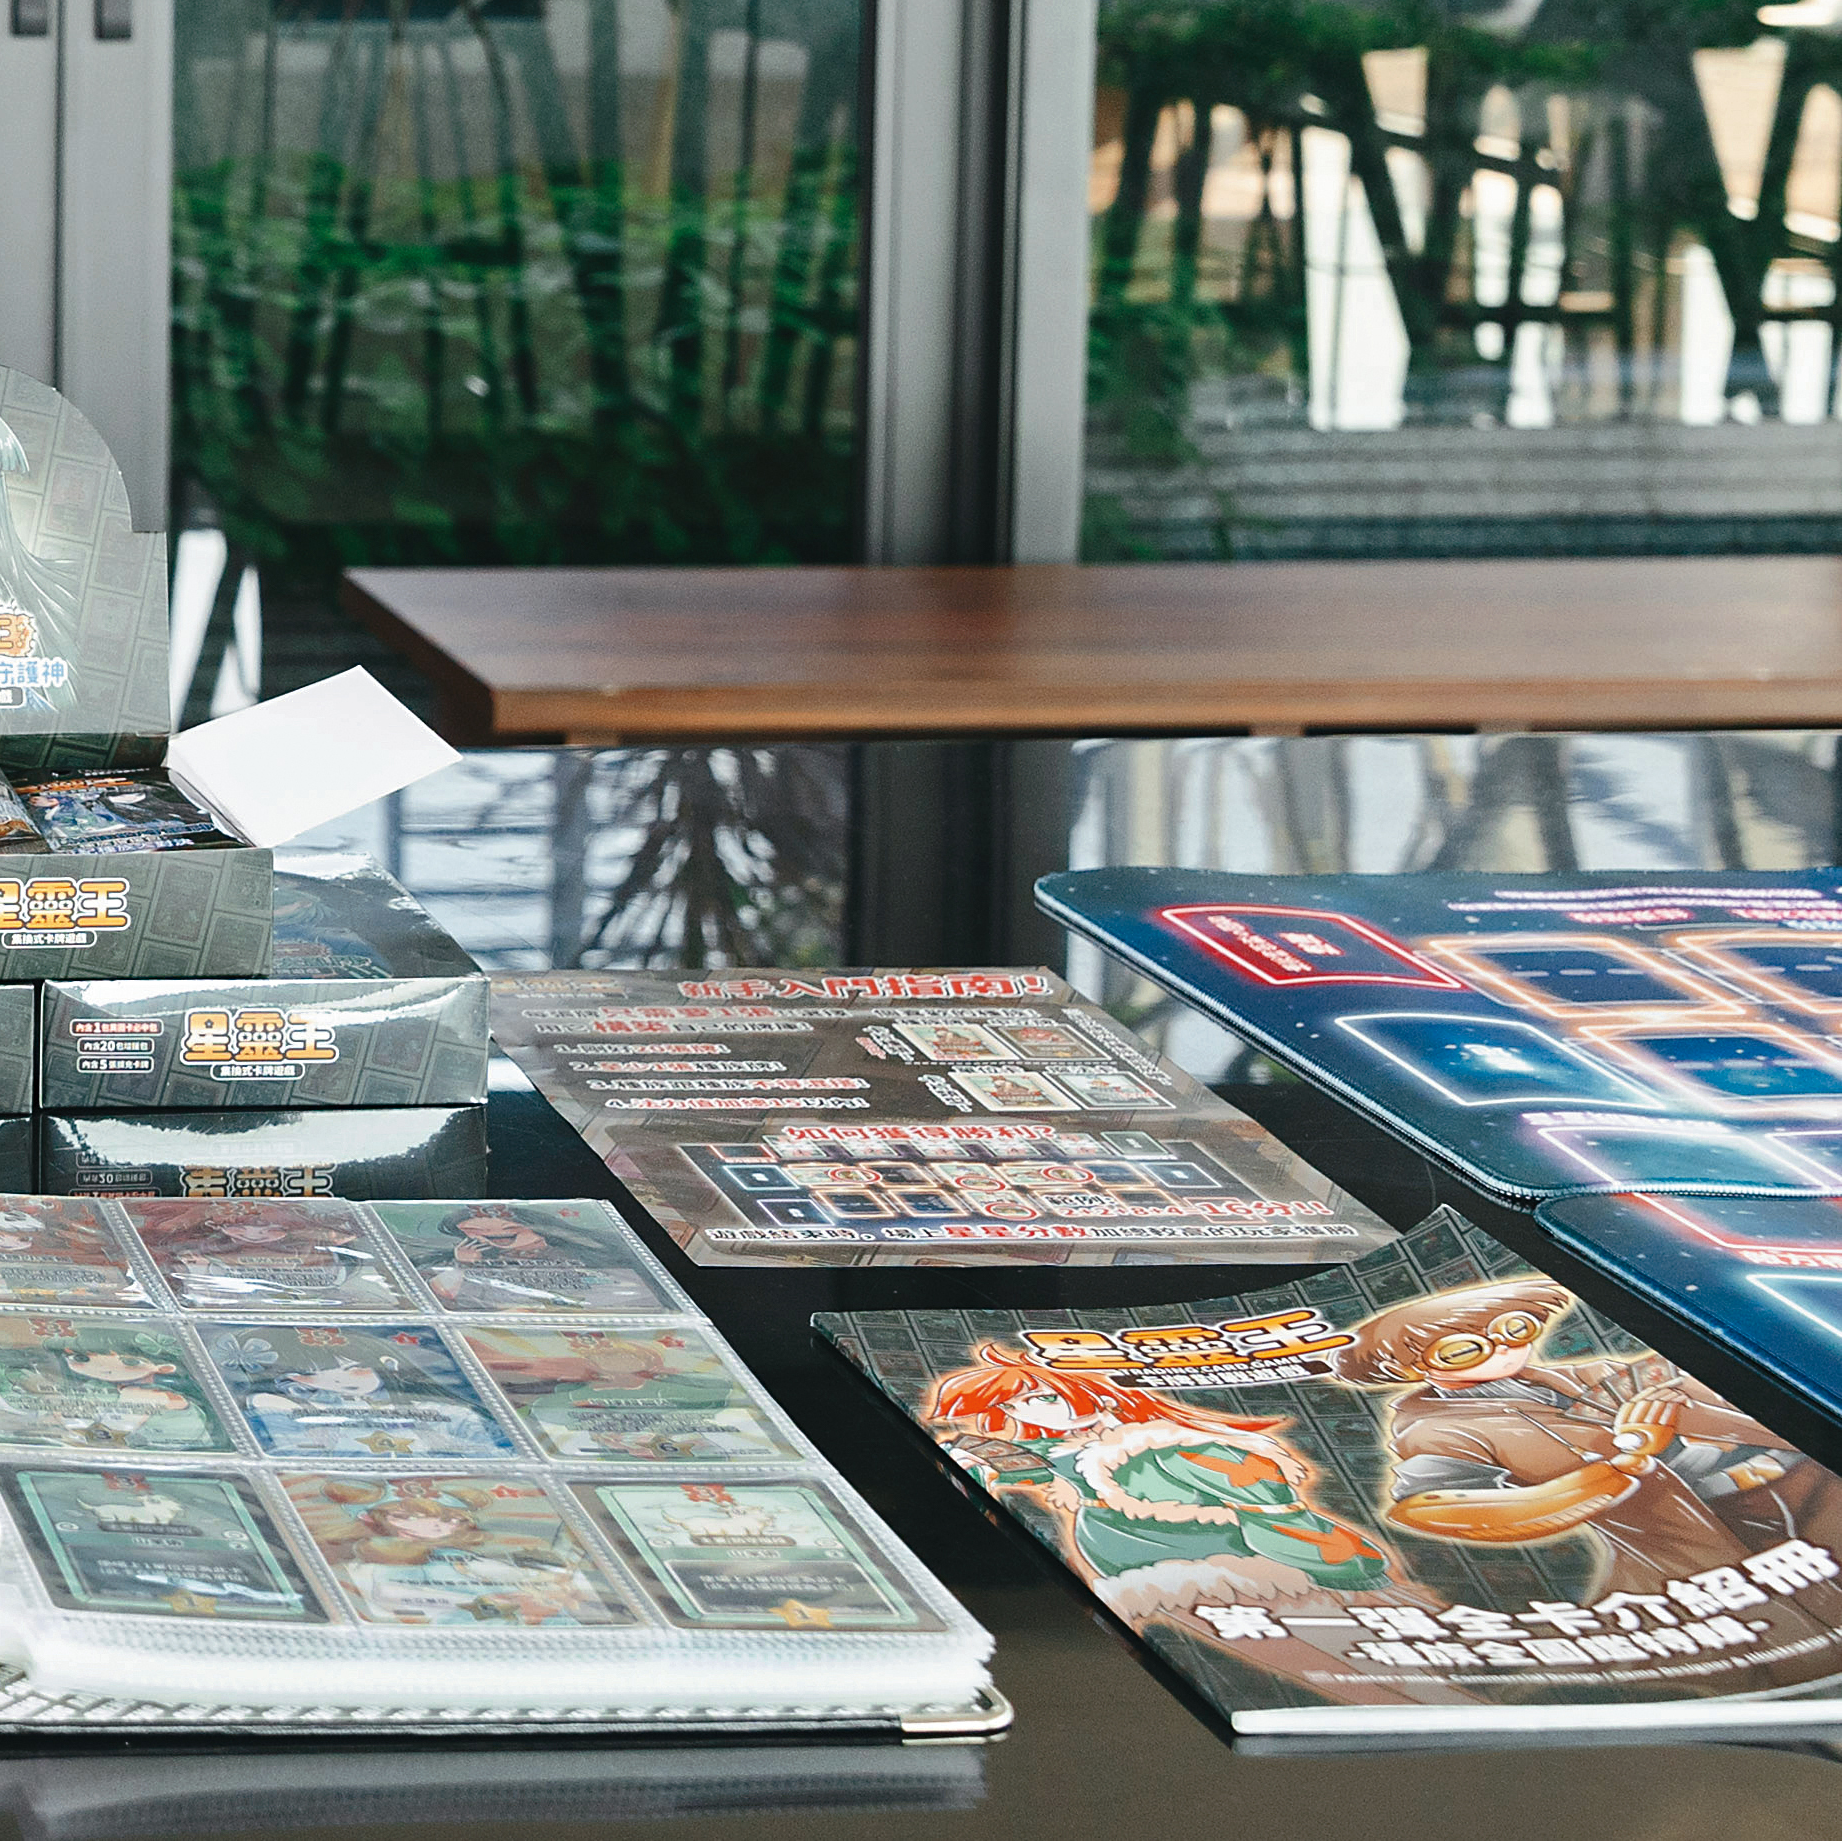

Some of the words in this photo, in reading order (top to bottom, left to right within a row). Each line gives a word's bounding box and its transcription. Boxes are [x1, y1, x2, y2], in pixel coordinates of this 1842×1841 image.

[10, 933, 88, 946] 集換式卡牌遊戲
[679, 974, 1052, 1000] 新手入門指南!
[183, 1012, 336, 1062] 星靈王
[220, 1065, 296, 1077] 集換式卡牌遊戲
[782, 1125, 1058, 1141] 如何獲得勝利?
[1022, 1309, 1356, 1370] 星靈王
[1135, 1365, 1311, 1387] 卡牌對戰遊戲
[1194, 1537, 1838, 1641] 第一彈全卡介紹冊
